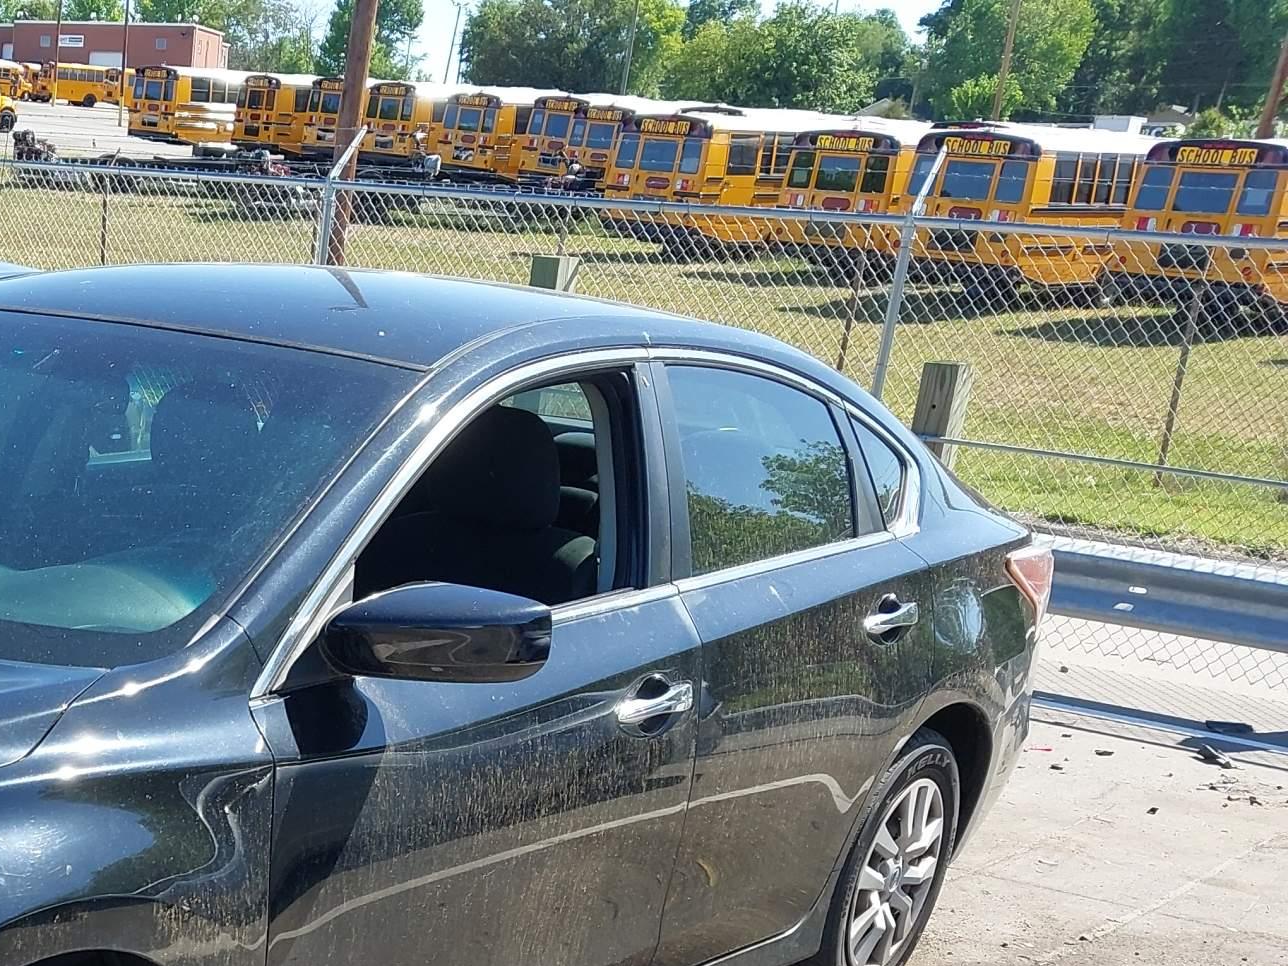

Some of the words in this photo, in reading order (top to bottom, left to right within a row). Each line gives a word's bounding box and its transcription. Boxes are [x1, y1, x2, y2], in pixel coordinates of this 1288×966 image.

[642, 119, 669, 133] SCHOOL
[673, 121, 690, 134] BUS
[818, 137, 850, 150] SCHOOL
[855, 138, 873, 150] BUS
[946, 138, 983, 153] SCHOOL
[987, 140, 1009, 155] BUS
[1178, 148, 1224, 163] SCHOOL
[1231, 149, 1255, 164] BUS
[906, 753, 951, 781] KELLY
